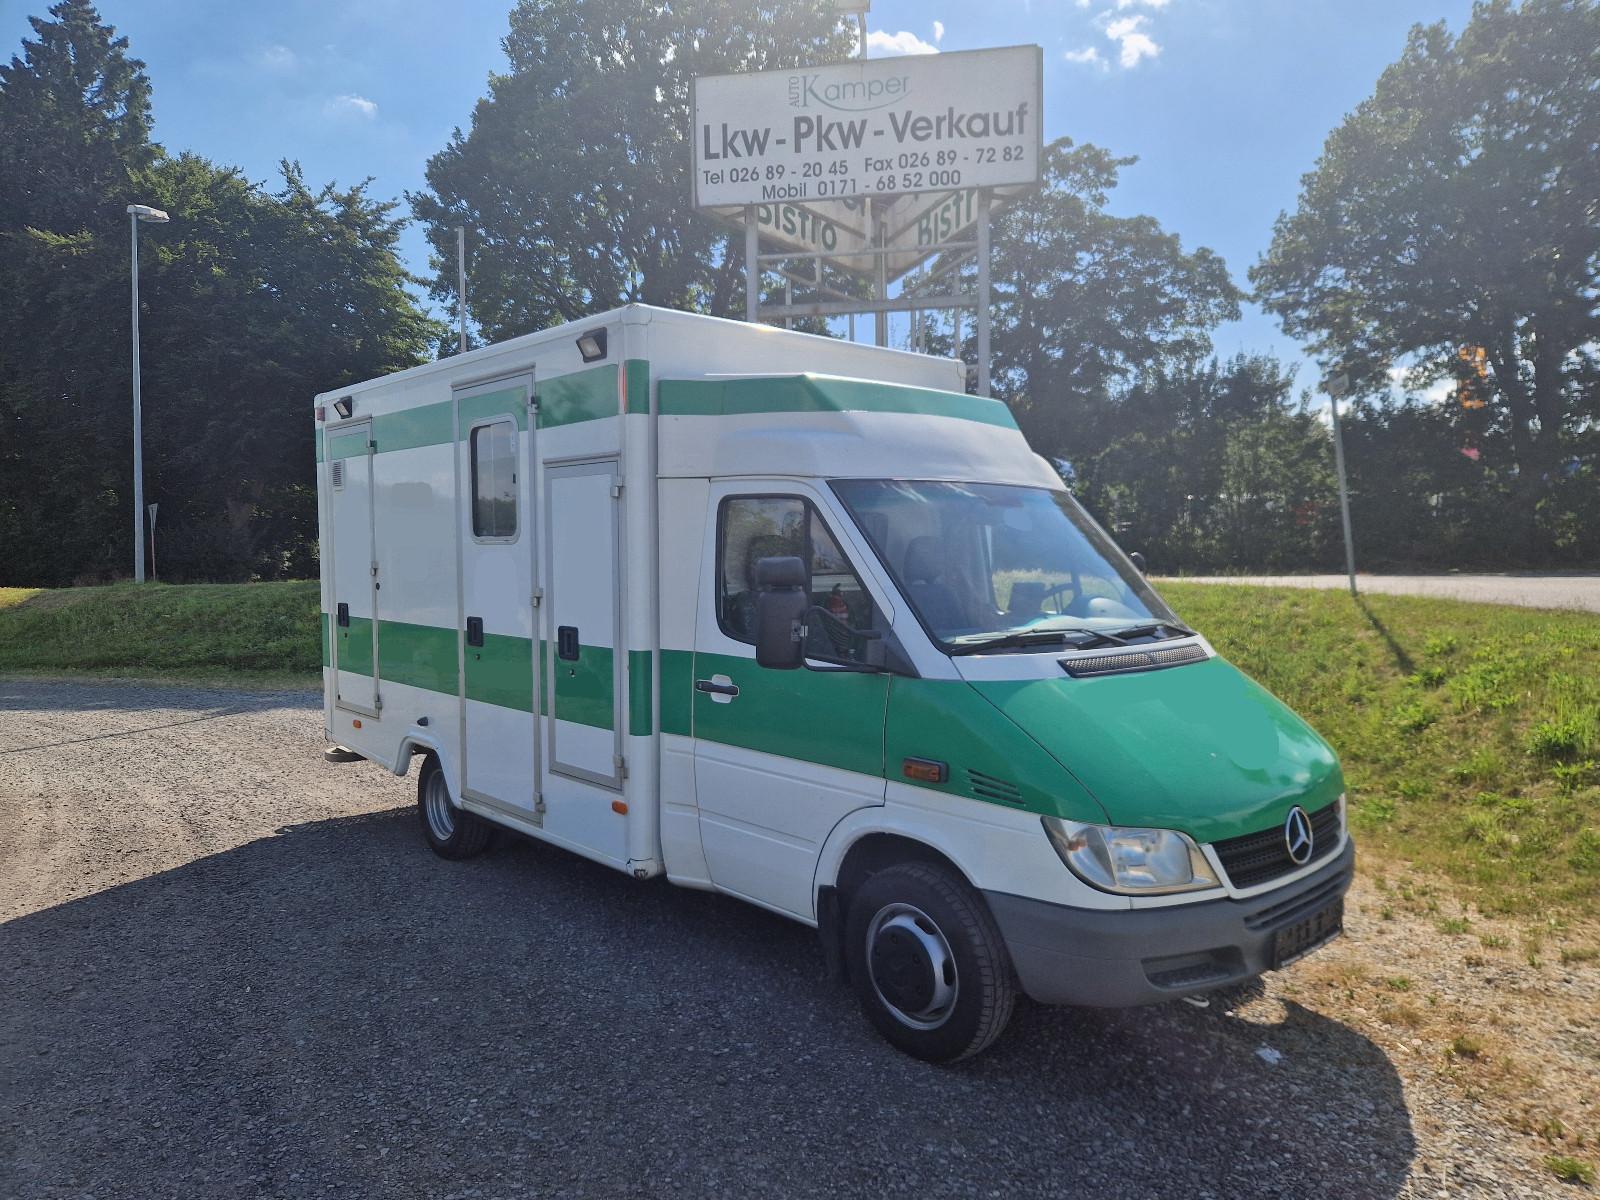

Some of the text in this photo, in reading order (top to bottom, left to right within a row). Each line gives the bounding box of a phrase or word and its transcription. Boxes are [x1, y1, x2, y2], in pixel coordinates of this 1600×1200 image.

[788, 76, 800, 108] AUTO
[801, 74, 911, 110] Kamper
[888, 101, 1029, 144] Verkauf
[703, 169, 725, 185] Tel
[729, 166, 760, 183] 026
[766, 164, 786, 181] 89
[802, 161, 823, 178] 20
[828, 159, 849, 176] 45
[864, 156, 894, 173] Fax
[898, 151, 930, 169] 026
[936, 149, 957, 166] 89
[975, 147, 997, 164] 72
[1002, 145, 1025, 162] 82
[762, 182, 807, 201] Mobil
[817, 178, 857, 196] 0171
[876, 174, 897, 192] 68
[902, 171, 923, 189] 52
[929, 169, 961, 187] 000
